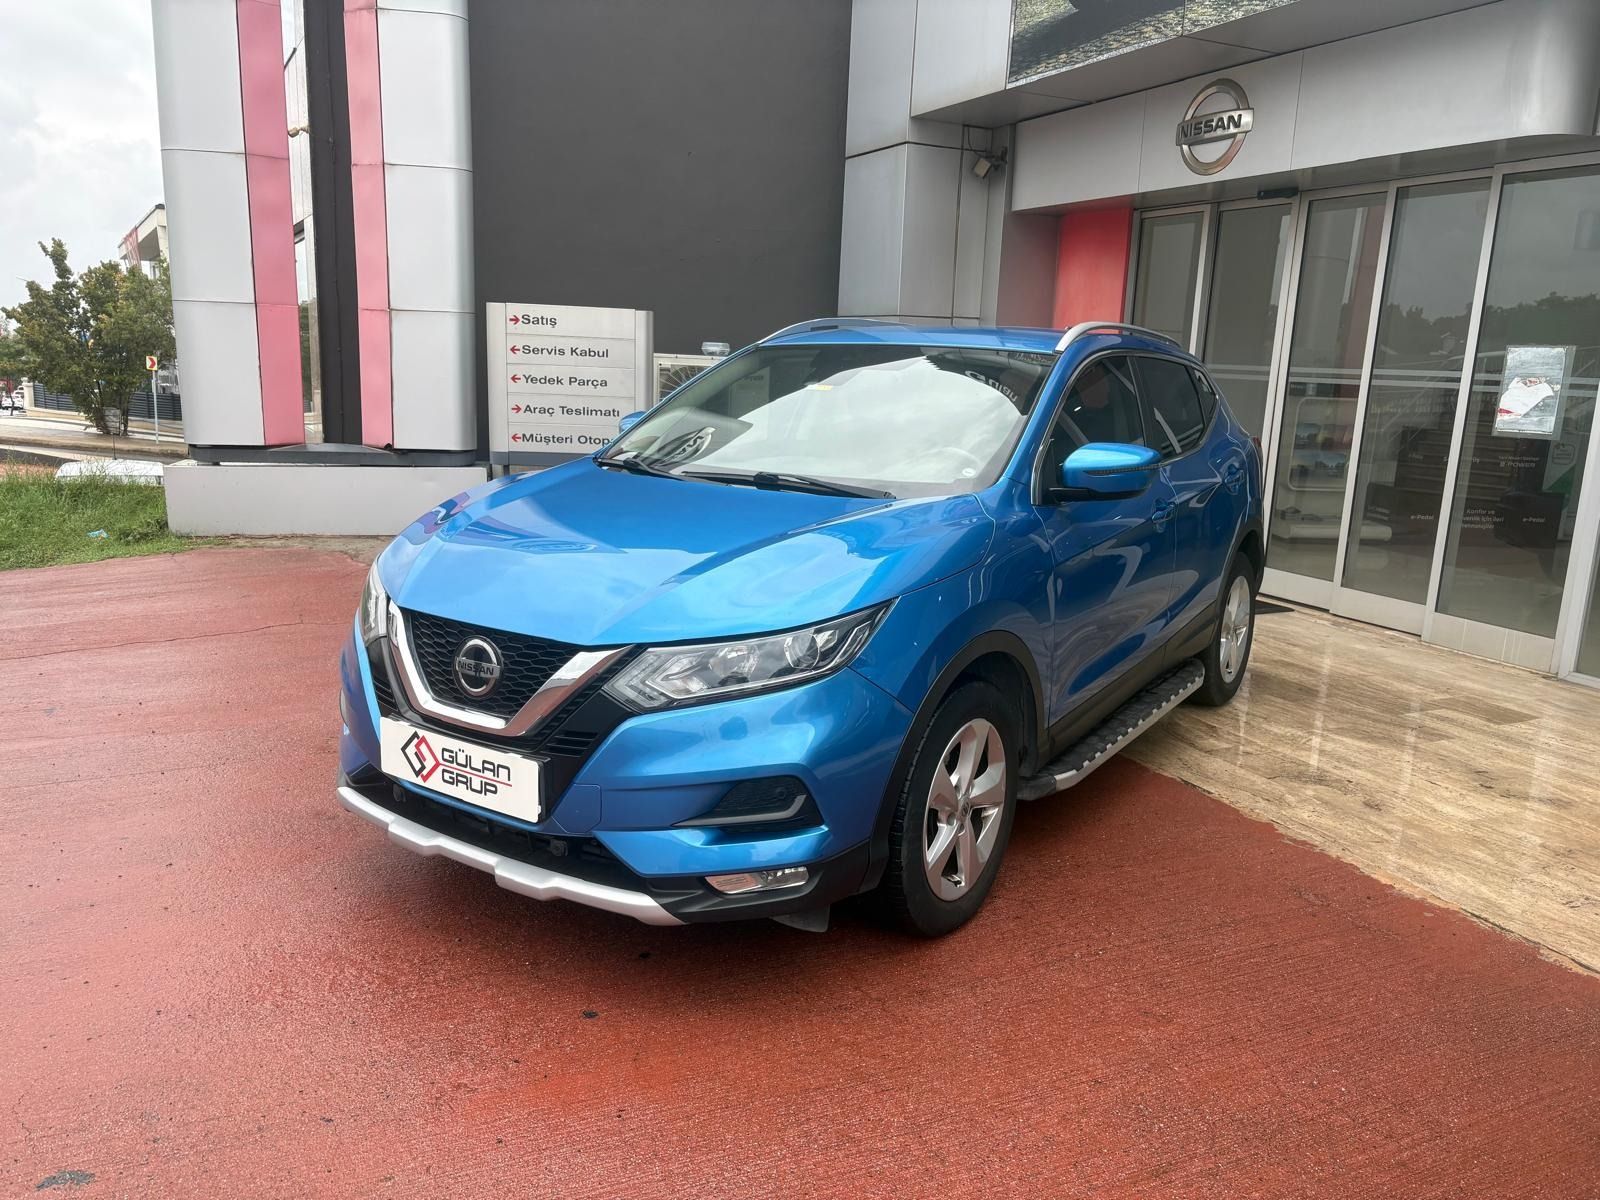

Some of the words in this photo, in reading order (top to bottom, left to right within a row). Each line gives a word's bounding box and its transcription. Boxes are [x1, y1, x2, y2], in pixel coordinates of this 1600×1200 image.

[1180, 114, 1243, 139] NISSAN
[521, 313, 558, 328] Satış
[521, 344, 566, 356] Servis
[570, 347, 609, 359] Kabul
[522, 374, 564, 386] Yedek
[568, 376, 608, 389] Parça
[523, 404, 555, 416] Araç
[559, 405, 620, 418] Teslimatı
[521, 433, 573, 446] Müşteri
[577, 435, 614, 447] Otop
[457, 659, 495, 677] NISSAN
[441, 747, 511, 782] GÜLAN
[441, 768, 499, 797] GRUP
